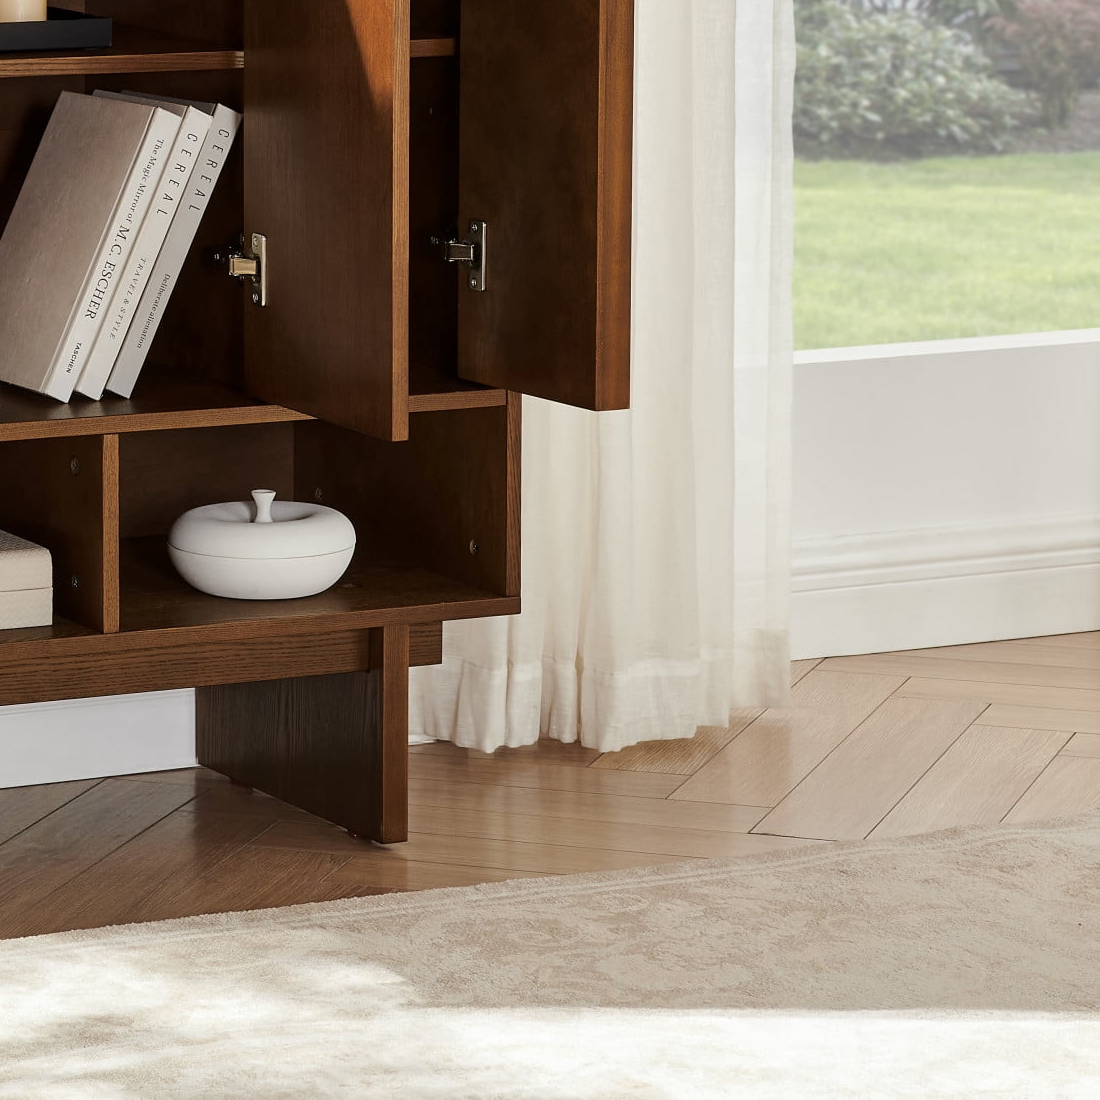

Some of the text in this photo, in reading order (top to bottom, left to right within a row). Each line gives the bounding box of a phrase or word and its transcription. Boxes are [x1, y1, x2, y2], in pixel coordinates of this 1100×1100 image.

[155, 132, 198, 216] CEREAL
[187, 128, 230, 211] CEREAL
[84, 138, 165, 320] The Magic Mirror of M.C. ESCHER
[108, 257, 147, 340] TRAVEL & STYLE
[65, 341, 83, 375] TASCHEN
